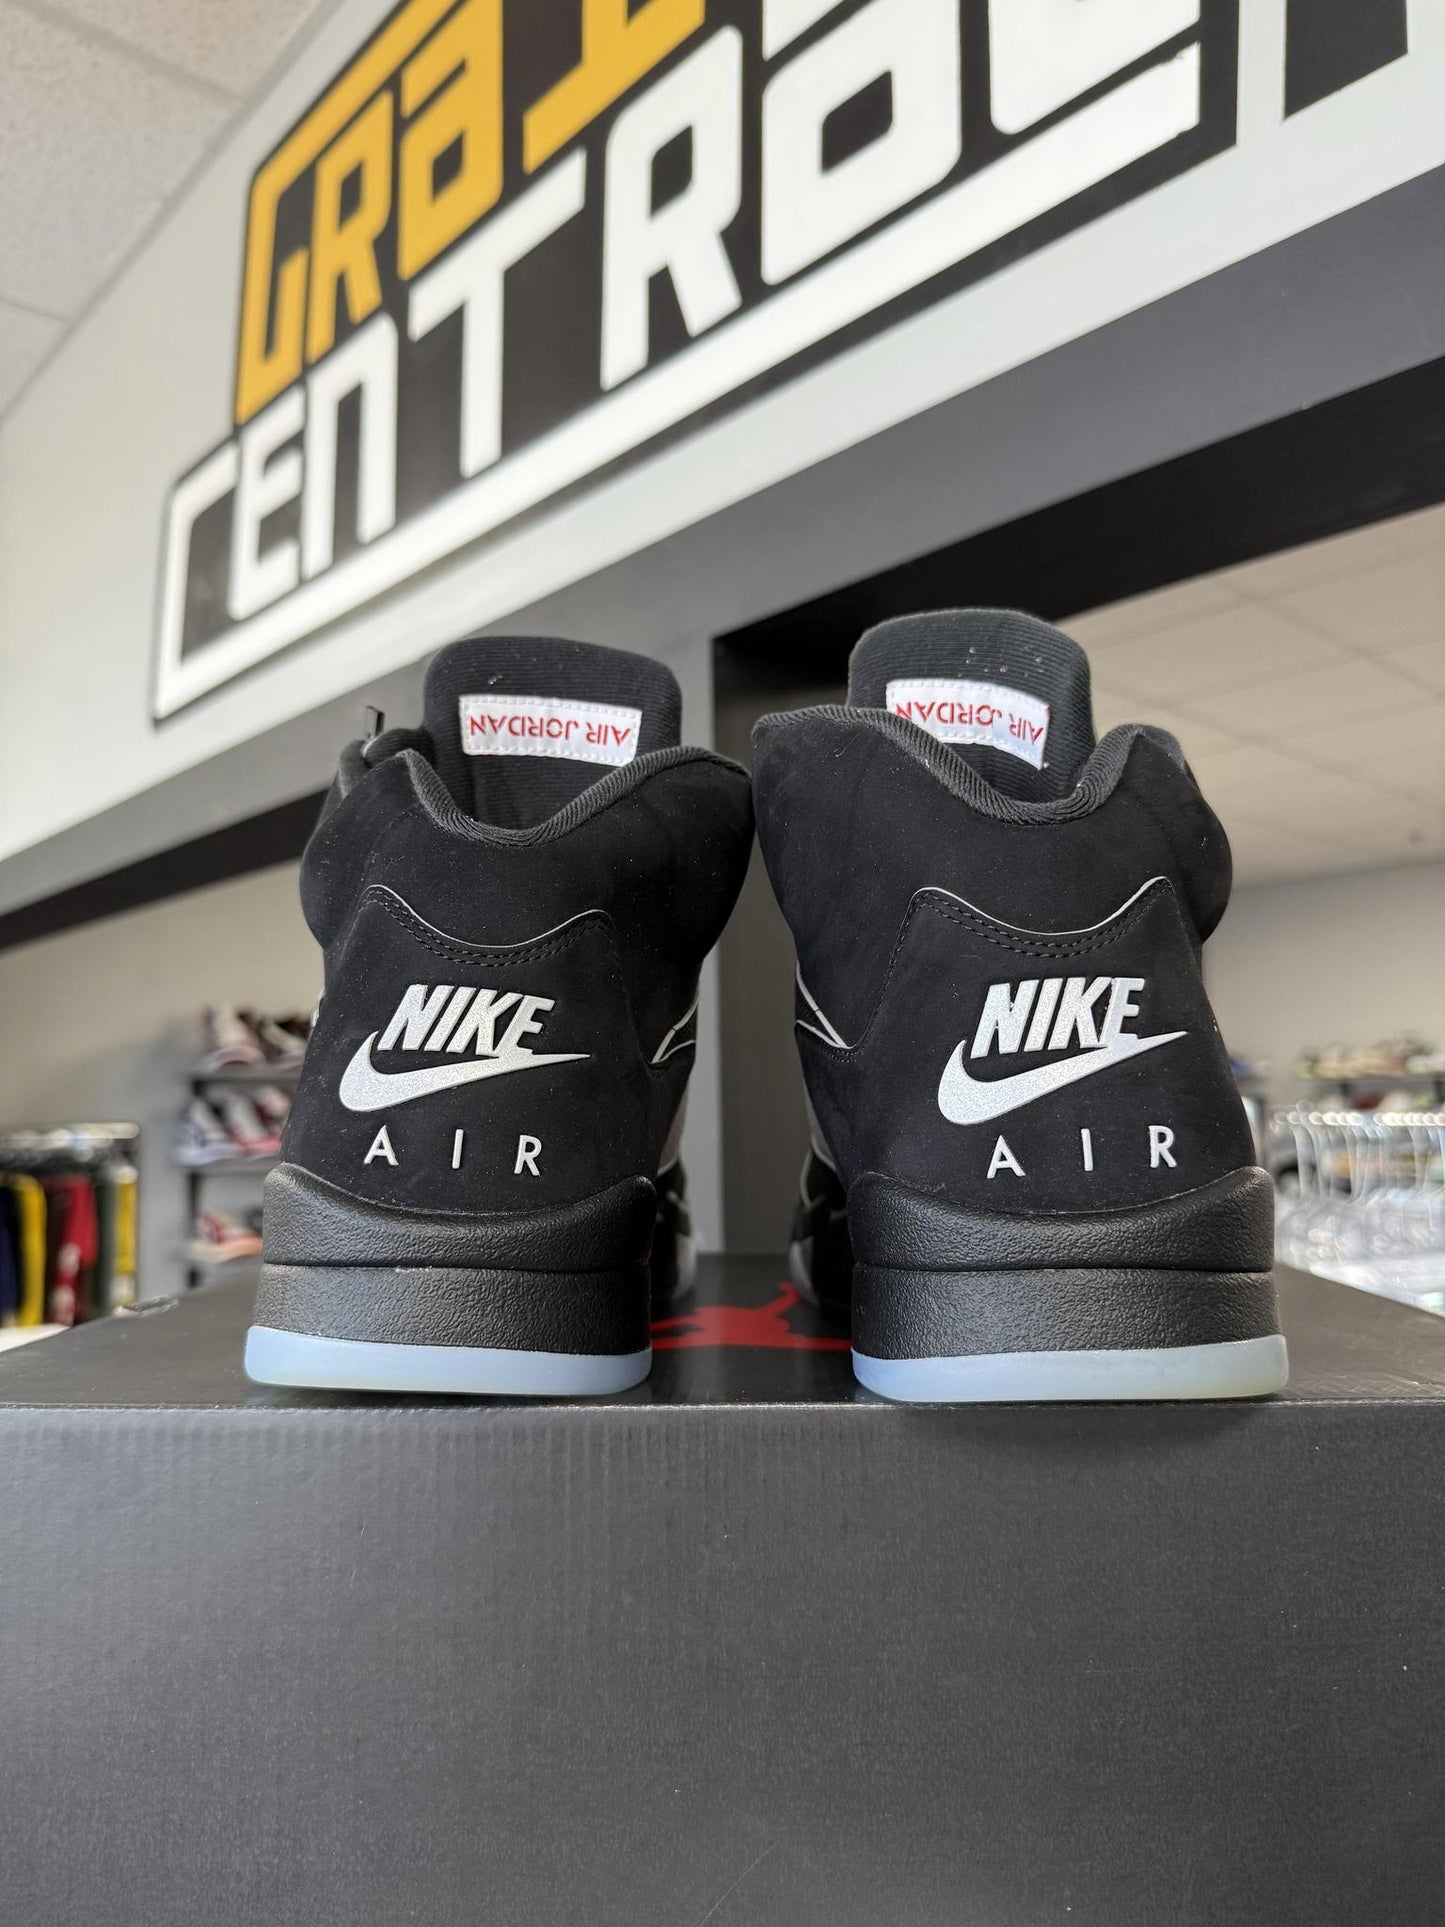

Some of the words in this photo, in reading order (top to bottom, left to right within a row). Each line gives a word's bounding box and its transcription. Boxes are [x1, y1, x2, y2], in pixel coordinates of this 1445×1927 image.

[470, 714, 579, 740] JORDAN
[586, 723, 631, 747] AIR
[1009, 713, 1044, 745] AIR
[377, 984, 555, 1057] NIKE
[970, 976, 1145, 1059] NIKE
[364, 1125, 542, 1176] AIR
[986, 1125, 1177, 1179] AIR
